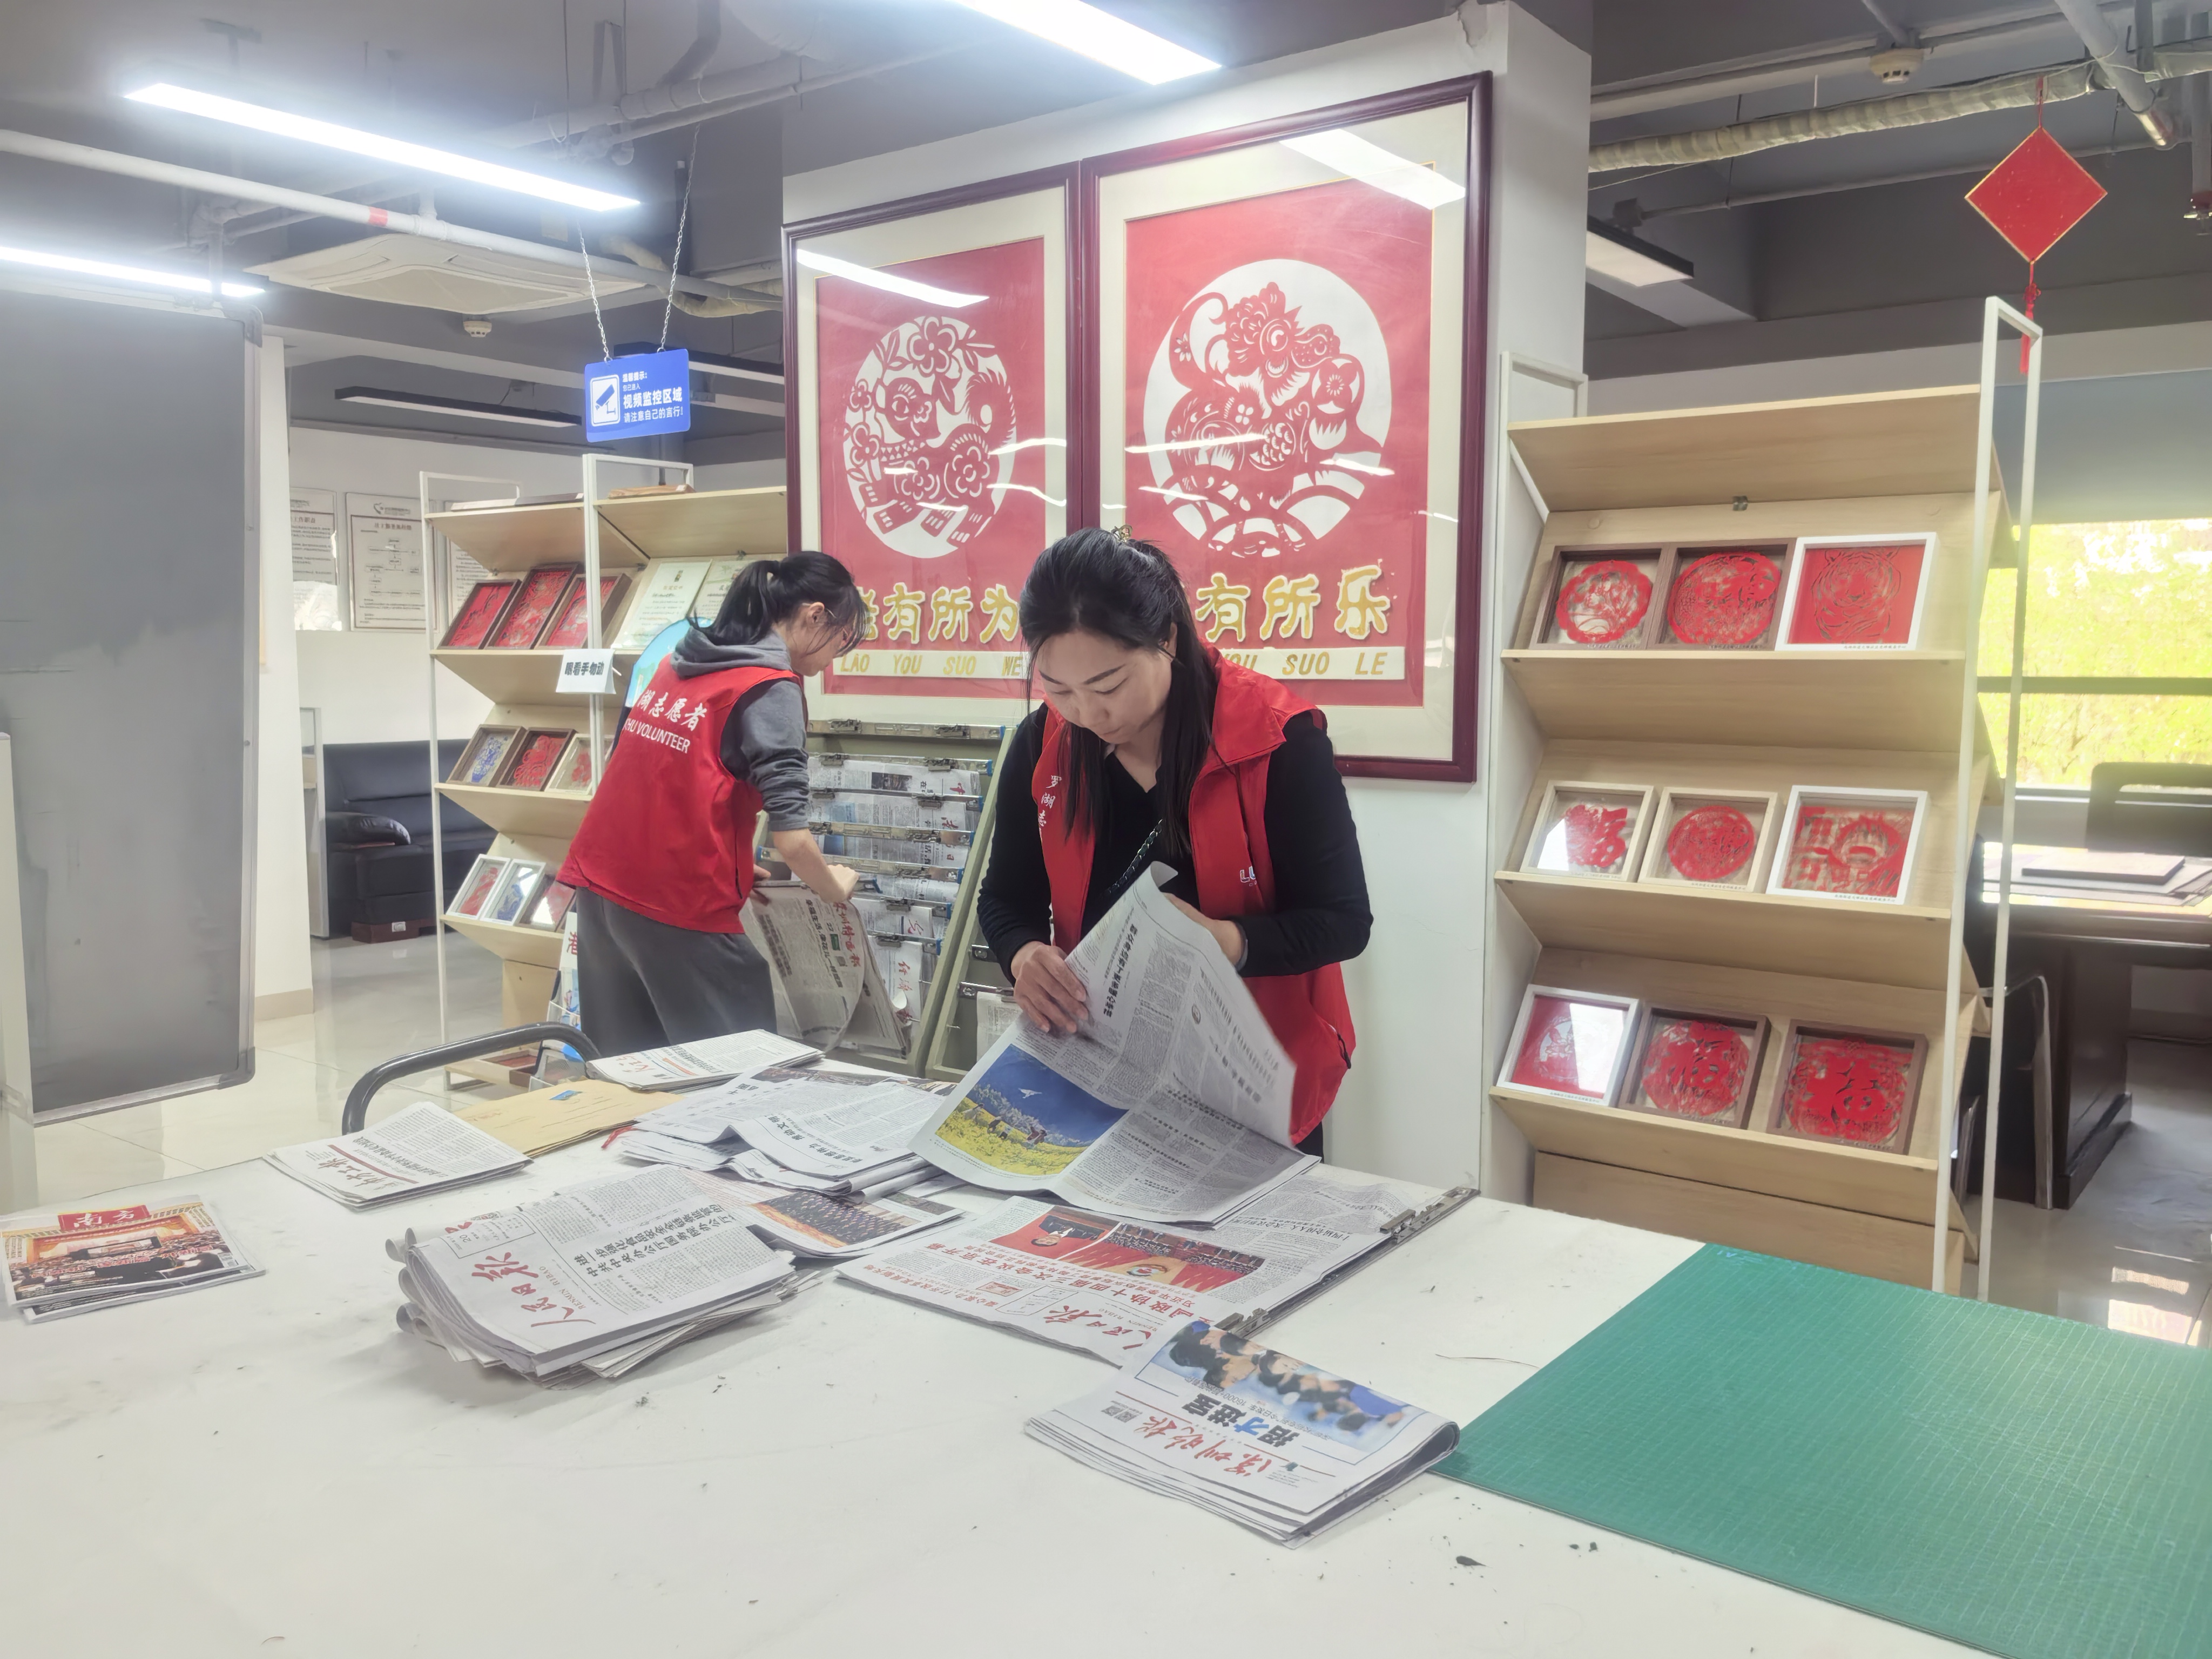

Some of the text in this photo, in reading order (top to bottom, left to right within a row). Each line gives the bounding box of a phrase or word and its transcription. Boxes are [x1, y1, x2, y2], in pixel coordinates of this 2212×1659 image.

[623, 386, 683, 409] 视频监控区域
[1195, 564, 1391, 643] 有所乐
[565, 661, 604, 676] 眼看手勿动
[840, 654, 870, 673] LAO
[893, 653, 922, 675] YOU
[943, 656, 977, 675] SUO
[1283, 651, 1330, 676] SUO
[1355, 652, 1388, 675] LE
[637, 721, 691, 754] VOLUNTEER
[1038, 774, 1062, 838] 罗湖志
[574, 1203, 725, 1267] 进一步强化食品安全全链条监管的
[586, 1214, 733, 1278] 中共中央办公厅国务院办公厅
[470, 1251, 597, 1328] 人民日报
[1181, 1392, 1301, 1449] 招才进宝
